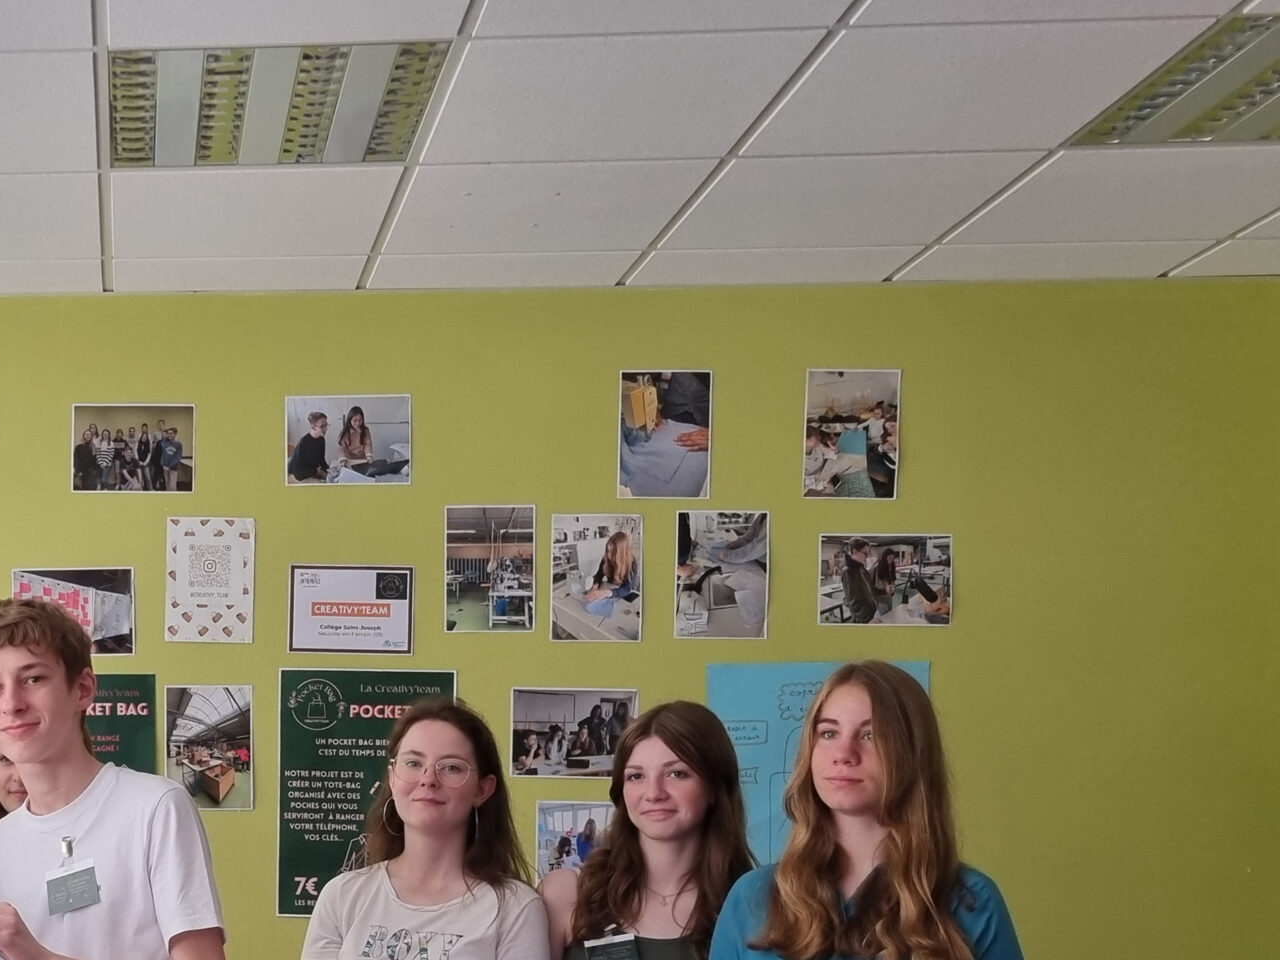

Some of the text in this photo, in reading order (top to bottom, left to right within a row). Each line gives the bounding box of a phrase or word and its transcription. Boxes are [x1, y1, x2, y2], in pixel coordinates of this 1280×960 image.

[360, 684, 373, 692] La
[85, 702, 149, 716] KET BAG
[351, 749, 375, 757] TEMPS
[311, 770, 338, 778] PROJET
[354, 771, 364, 779] DE
[311, 780, 322, 788] UN
[324, 781, 361, 789] TOTE-BAG
[288, 790, 325, 799] ORGANISÉ
[347, 792, 361, 800] DES
[321, 802, 336, 810] QUI
[283, 812, 325, 820] SERVIRONT
[335, 813, 365, 821] RANGER
[289, 823, 314, 831] VOTRE
[304, 833, 320, 841] VOS
[294, 876, 318, 896] 7€
